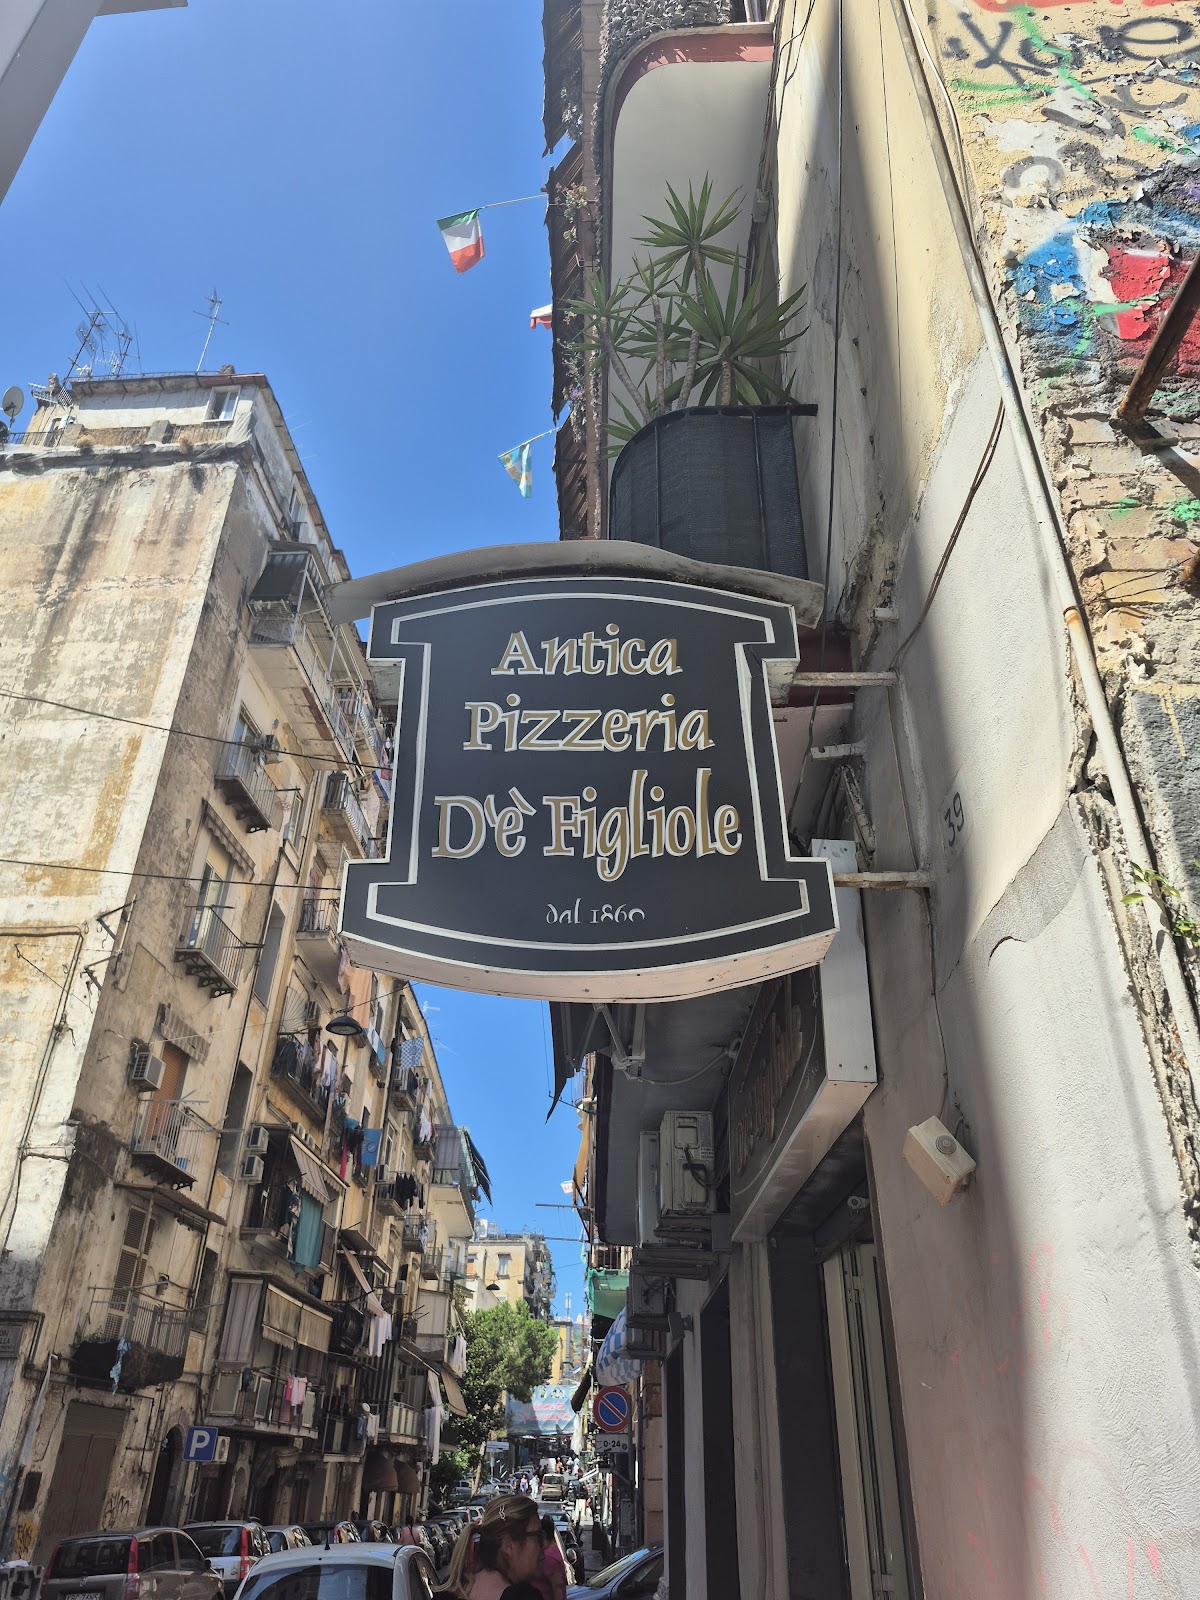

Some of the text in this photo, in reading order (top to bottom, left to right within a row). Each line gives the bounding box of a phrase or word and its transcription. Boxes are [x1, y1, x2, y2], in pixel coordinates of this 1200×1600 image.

[491, 623, 683, 676] Antica
[463, 693, 716, 752] Pizzeria
[543, 768, 743, 882] Figliole
[944, 792, 965, 847] 39
[546, 898, 645, 924] dal 1860
[189, 1430, 210, 1457] P
